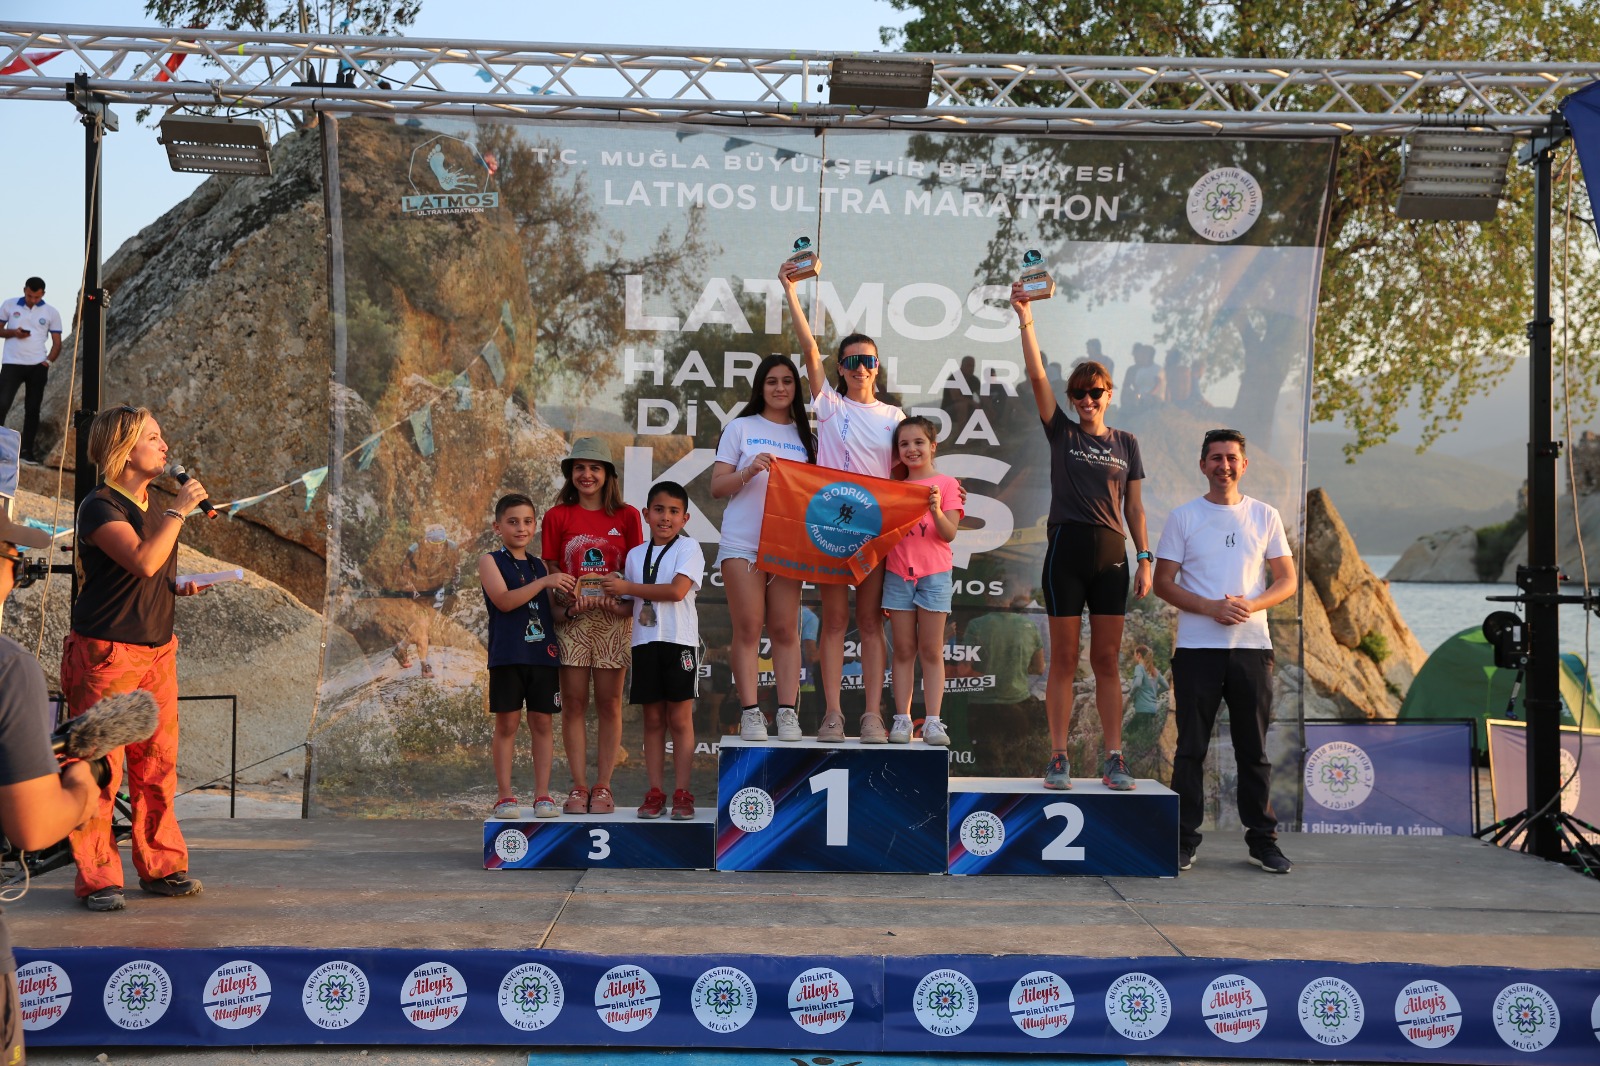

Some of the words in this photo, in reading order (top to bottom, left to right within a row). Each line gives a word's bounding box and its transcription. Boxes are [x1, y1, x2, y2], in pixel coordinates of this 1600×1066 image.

[531, 149, 587, 165] T.C.
[601, 149, 710, 169] MUĞLA
[724, 154, 925, 179] BÜYÜKŞEHİR
[940, 159, 1125, 182] BELEDİYESİ
[405, 194, 494, 210] LATMOS
[605, 179, 757, 210] LATMOS
[770, 184, 897, 214] ULTRA
[904, 188, 1119, 220] MARATHON
[443, 207, 485, 215] MARATHON
[1203, 227, 1237, 239] MUĞLA
[624, 274, 1021, 342] LATMOS
[822, 487, 873, 509] BODRUM
[810, 524, 846, 553] RUNNING
[808, 768, 849, 846] 1
[1041, 802, 1085, 860] 2
[588, 828, 611, 860] 3
[18, 966, 52, 978] BİRLİKTE
[218, 965, 252, 977] BİRLİKTE
[414, 967, 447, 978] BİRLİKTE
[607, 970, 640, 980] BİRLİKTE
[800, 972, 833, 983] BİRLİKTE
[112, 963, 150, 988] BÜYÜKŞEHİR
[152, 969, 168, 1005] BELEDİYESİ
[213, 973, 256, 996] Aileyiz
[308, 963, 348, 989] BÜYÜKŞEHİR
[350, 969, 365, 1006] BELEDİYESİ
[410, 975, 453, 996] Aileyiz
[503, 966, 541, 990] BÜYÜKŞEHİR
[543, 970, 560, 1007] BELEDİYESİ
[603, 977, 646, 998] Aileyiz
[696, 969, 734, 993] BÜYÜKŞEHİR
[735, 973, 753, 1009] BELEDİYESİ
[1021, 976, 1053, 987] BİRLİKTE
[1212, 979, 1245, 991] BİRLİKTE
[796, 980, 839, 1002] Aileyiz
[918, 972, 955, 997] BÜYÜKŞEHİR
[958, 976, 974, 1013] BELEDİYESİ
[1018, 984, 1059, 1005] Aileyiz
[1110, 975, 1146, 1000] BÜYÜKŞEHİR
[1148, 979, 1167, 1017] BELEDİYESİ
[1210, 988, 1252, 1009] Aileyiz
[1405, 985, 1438, 996] BİRLİKTE
[220, 995, 254, 1007] BİRLİKTE
[417, 997, 451, 1008] BİRLİKTE
[611, 999, 645, 1010] BİRLİKTE
[805, 1002, 838, 1012] BİRLİKTE
[1302, 980, 1339, 1005] BÜYÜKŞEHİR
[1341, 984, 1360, 1022] BELEDİYESİ
[1404, 993, 1446, 1015] Aileyiz
[1497, 985, 1533, 1010] BÜYÜKŞEHİR
[1535, 990, 1556, 1029] BELEDİYESİ
[22, 1005, 62, 1023] uğlayız
[213, 1005, 261, 1021] Muğlayız
[410, 1005, 458, 1022] Muğlayız
[605, 1008, 652, 1024] Muğlayız
[799, 1010, 845, 1026] Muğlayız
[1026, 1005, 1059, 1016] BİRLİKTE
[1219, 1009, 1252, 1020] BİRLİKTE
[118, 1018, 150, 1028] MUĞLA
[317, 1018, 348, 1027] MUĞLA
[513, 1019, 545, 1029] MUĞLA
[708, 1022, 739, 1031] MUĞLA
[1021, 1014, 1067, 1031] Muğlayız
[1214, 1019, 1260, 1035] Muğlayız
[1413, 1015, 1446, 1026] BİRLİKTE
[930, 1025, 961, 1034] MUĞLA
[1123, 1029, 1154, 1038] MUĞLA
[1408, 1024, 1455, 1040] Muğlayız
[1316, 1034, 1347, 1043] MUĞLA
[1512, 1040, 1543, 1050] MUĞLA
